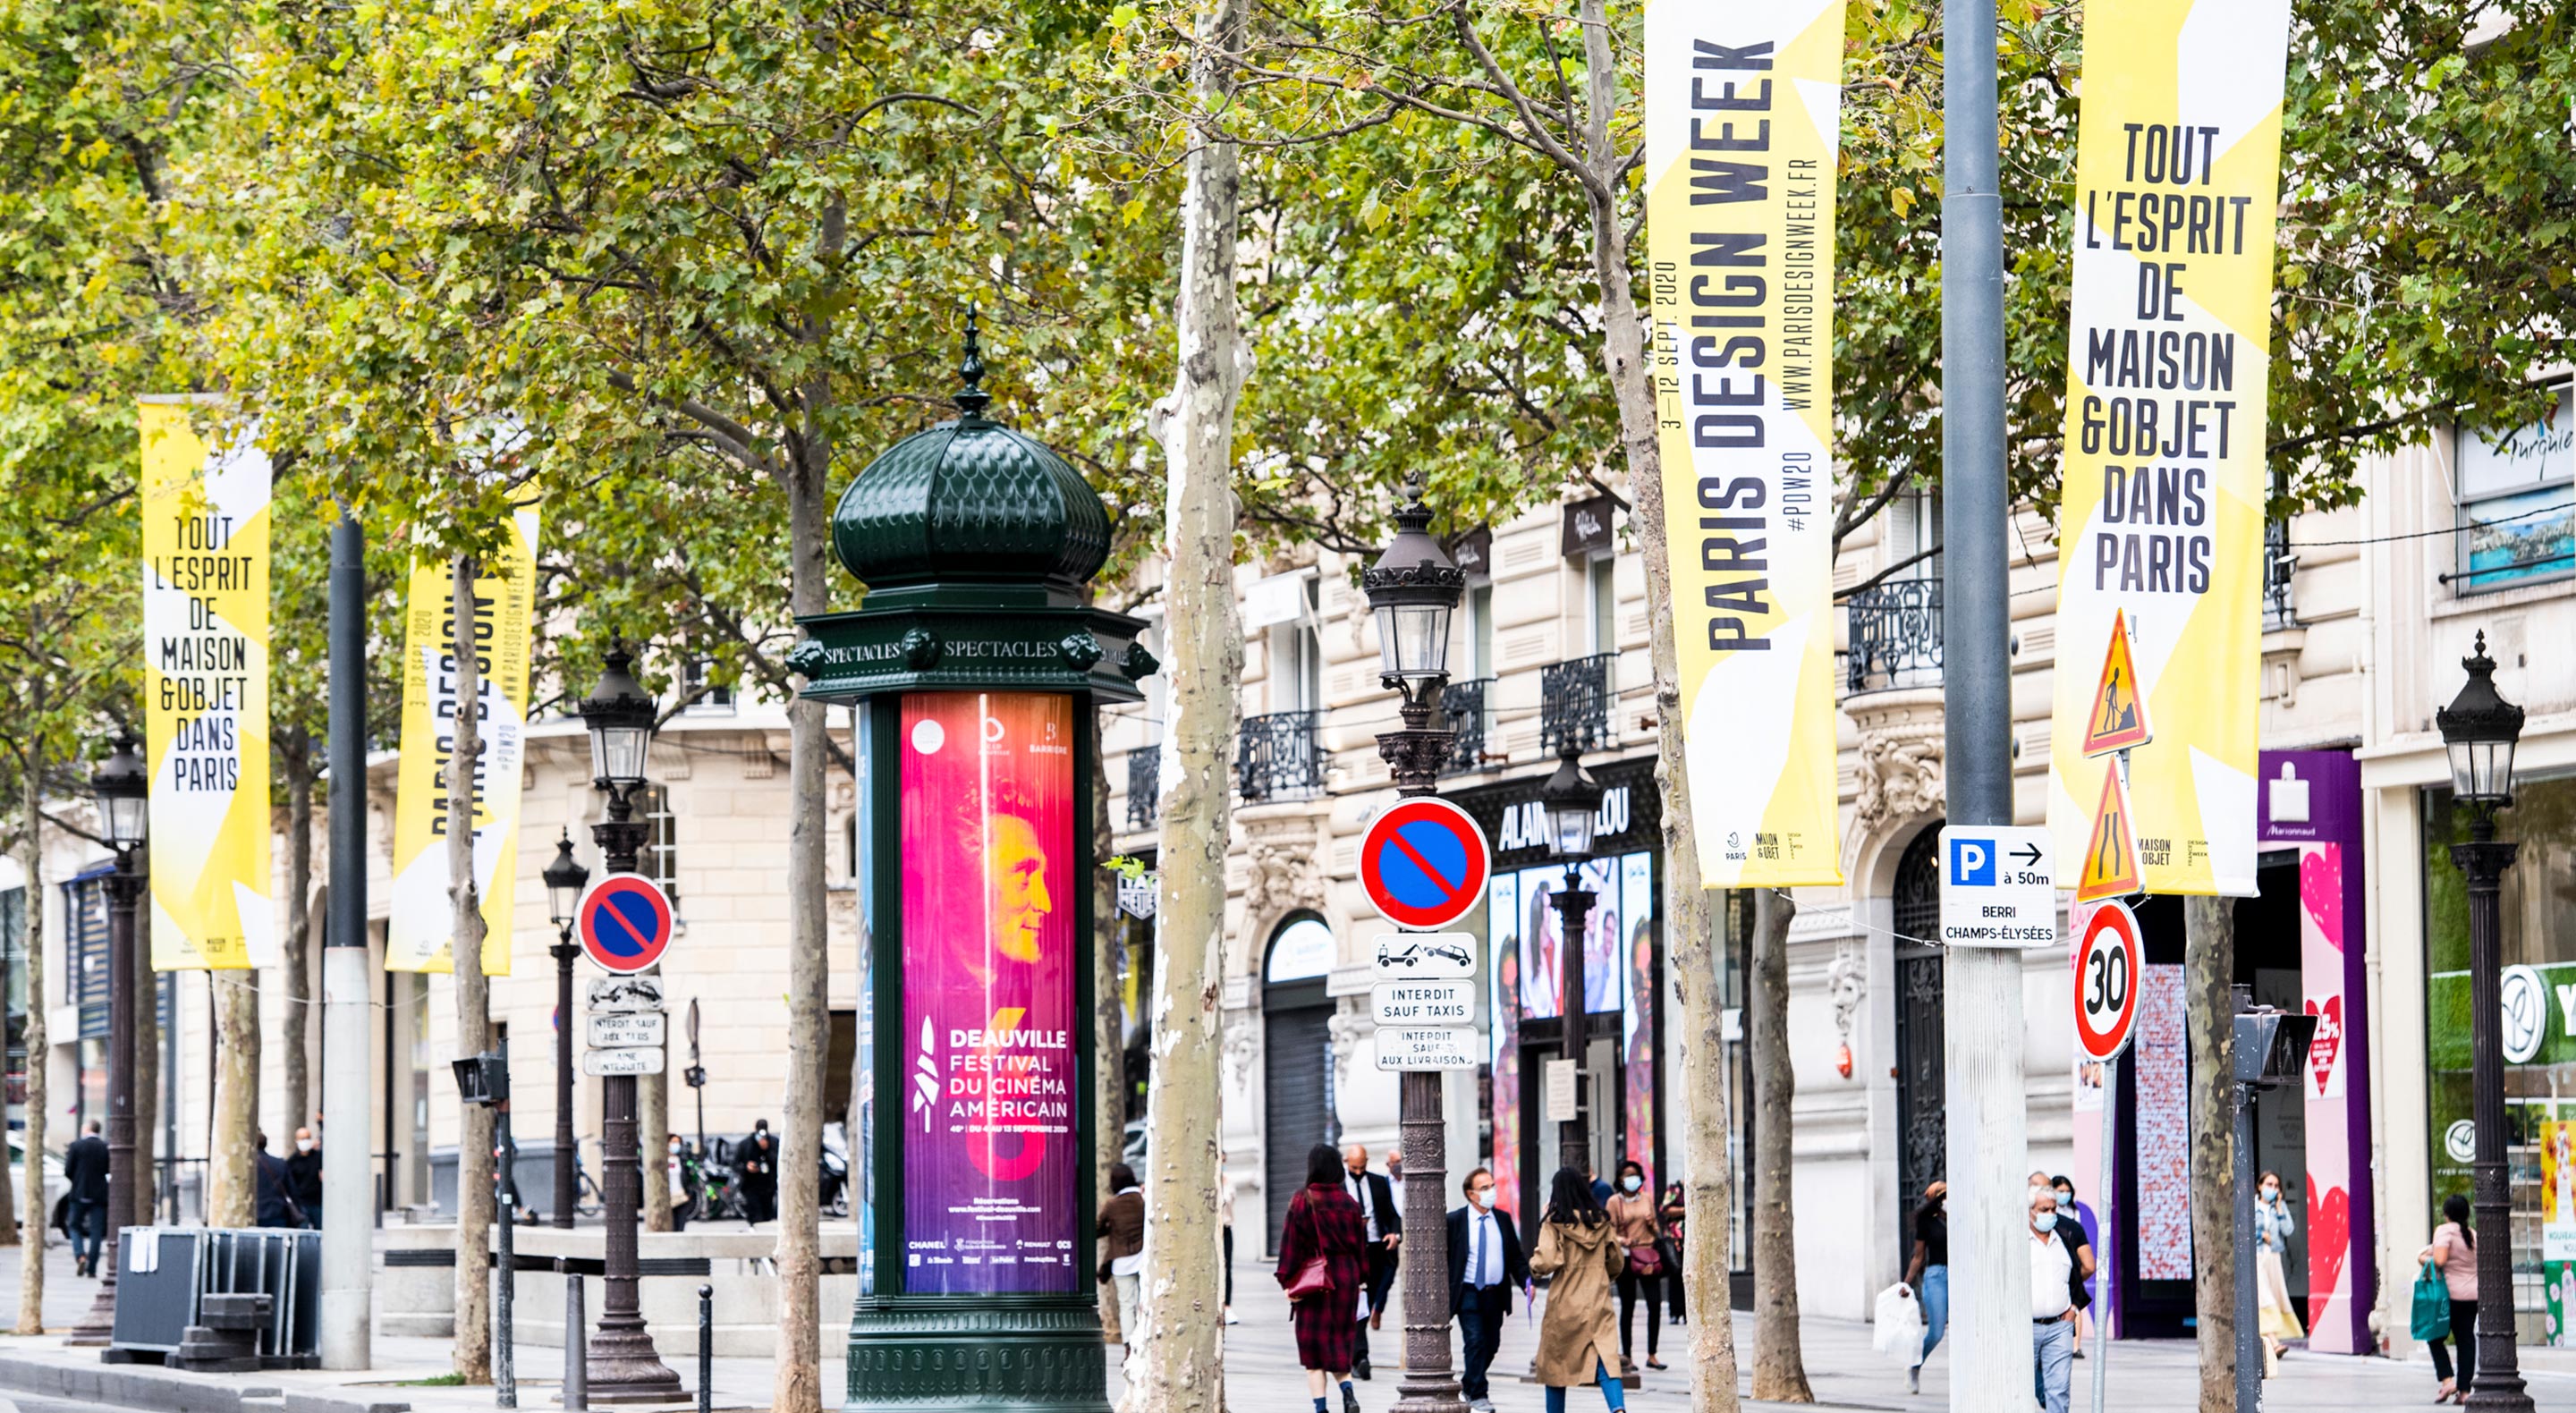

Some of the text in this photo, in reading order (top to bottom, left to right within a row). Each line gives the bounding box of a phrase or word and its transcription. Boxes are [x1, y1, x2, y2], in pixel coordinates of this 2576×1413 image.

[2123, 123, 2220, 186] TOUT
[2086, 190, 2252, 255] L'ESPRIT
[1654, 261, 1677, 306] 2020
[1783, 158, 1818, 411] WWW.PARISDESIGNWEEK.FR
[2137, 261, 2187, 322] DE
[1657, 316, 1679, 366] SEPT.
[1690, 38, 1775, 651] PARIS DESIGN WEEK
[2086, 326, 2235, 392] MAISON
[2080, 395, 2236, 460] &OBJET
[1783, 452, 1812, 532] #PDW20
[2103, 465, 2207, 527] DANS
[174, 516, 233, 551] TOUT
[156, 555, 253, 591] L'ESPRIT
[2096, 532, 2211, 595] PARIS
[189, 597, 217, 631] DE
[161, 637, 246, 671] MAISON
[825, 642, 901, 664] SPECTACLES
[944, 640, 1058, 658] SPECTACLES
[160, 677, 248, 712] &OBJET
[176, 716, 234, 752] DANS
[174, 757, 238, 792] PARIS
[1725, 851, 1747, 860] PARIS
[2138, 838, 2172, 852] MAISON
[2004, 871, 2049, 885] à 50m
[1982, 906, 2016, 918] BERRI
[1945, 925, 2054, 941] CHAMPS-ÉLYSÉES
[1392, 988, 1455, 1001] INTERDIT
[2086, 945, 2127, 1015] 30
[1384, 1004, 1465, 1018] SAUF TAXIS
[949, 1028, 1067, 1049] DEAUVILLE
[1402, 1031, 1453, 1041] INTERDIT
[950, 1054, 1053, 1072] FESTIVAL
[1381, 1056, 1402, 1065] AUX
[950, 1074, 1067, 1096] DU CINÉMA
[949, 1097, 1068, 1118] AMÉRICAIN
[909, 1240, 946, 1250] CHANEL
